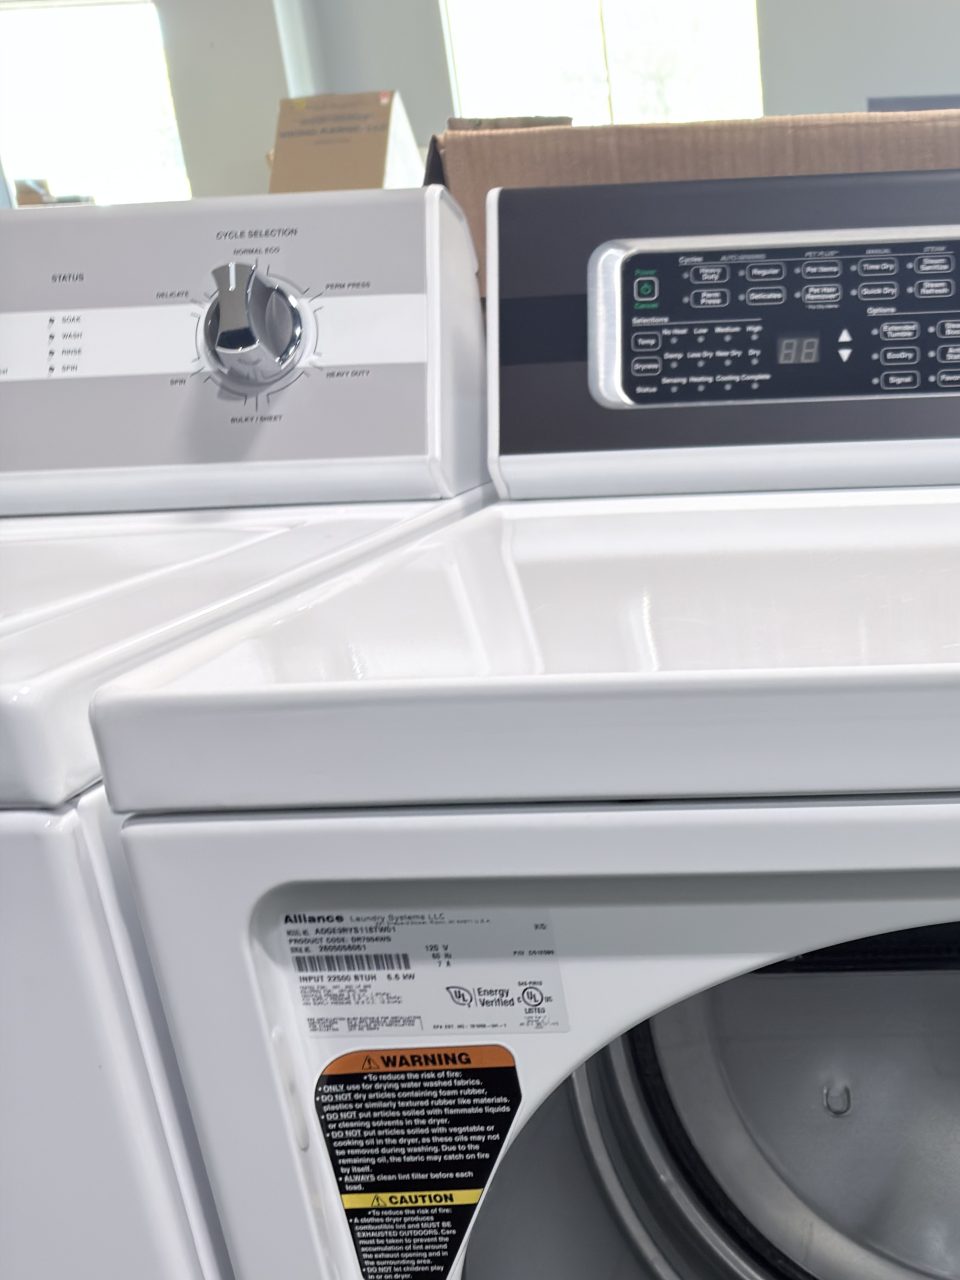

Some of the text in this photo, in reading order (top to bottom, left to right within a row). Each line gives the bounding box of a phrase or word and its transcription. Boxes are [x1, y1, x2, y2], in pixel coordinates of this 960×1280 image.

[216, 228, 298, 240] CYCLE SELECTION
[52, 272, 84, 283] STATUS
[284, 914, 344, 924] Alliance
[477, 987, 509, 997] Energy
[479, 998, 514, 1007] Verified
[381, 1052, 472, 1068] WARNING
[323, 1084, 344, 1092] ONLY
[321, 1094, 333, 1102] DO
[335, 1093, 352, 1101] NOT
[323, 1103, 353, 1112] plastics
[326, 1113, 338, 1121] DO
[345, 1129, 361, 1137] NOT
[449, 1125, 484, 1134] vegetable
[407, 1145, 440, 1153] washing.
[341, 1166, 350, 1174] by
[345, 1174, 375, 1182] ALWAYS
[389, 1194, 454, 1204] CAUTION
